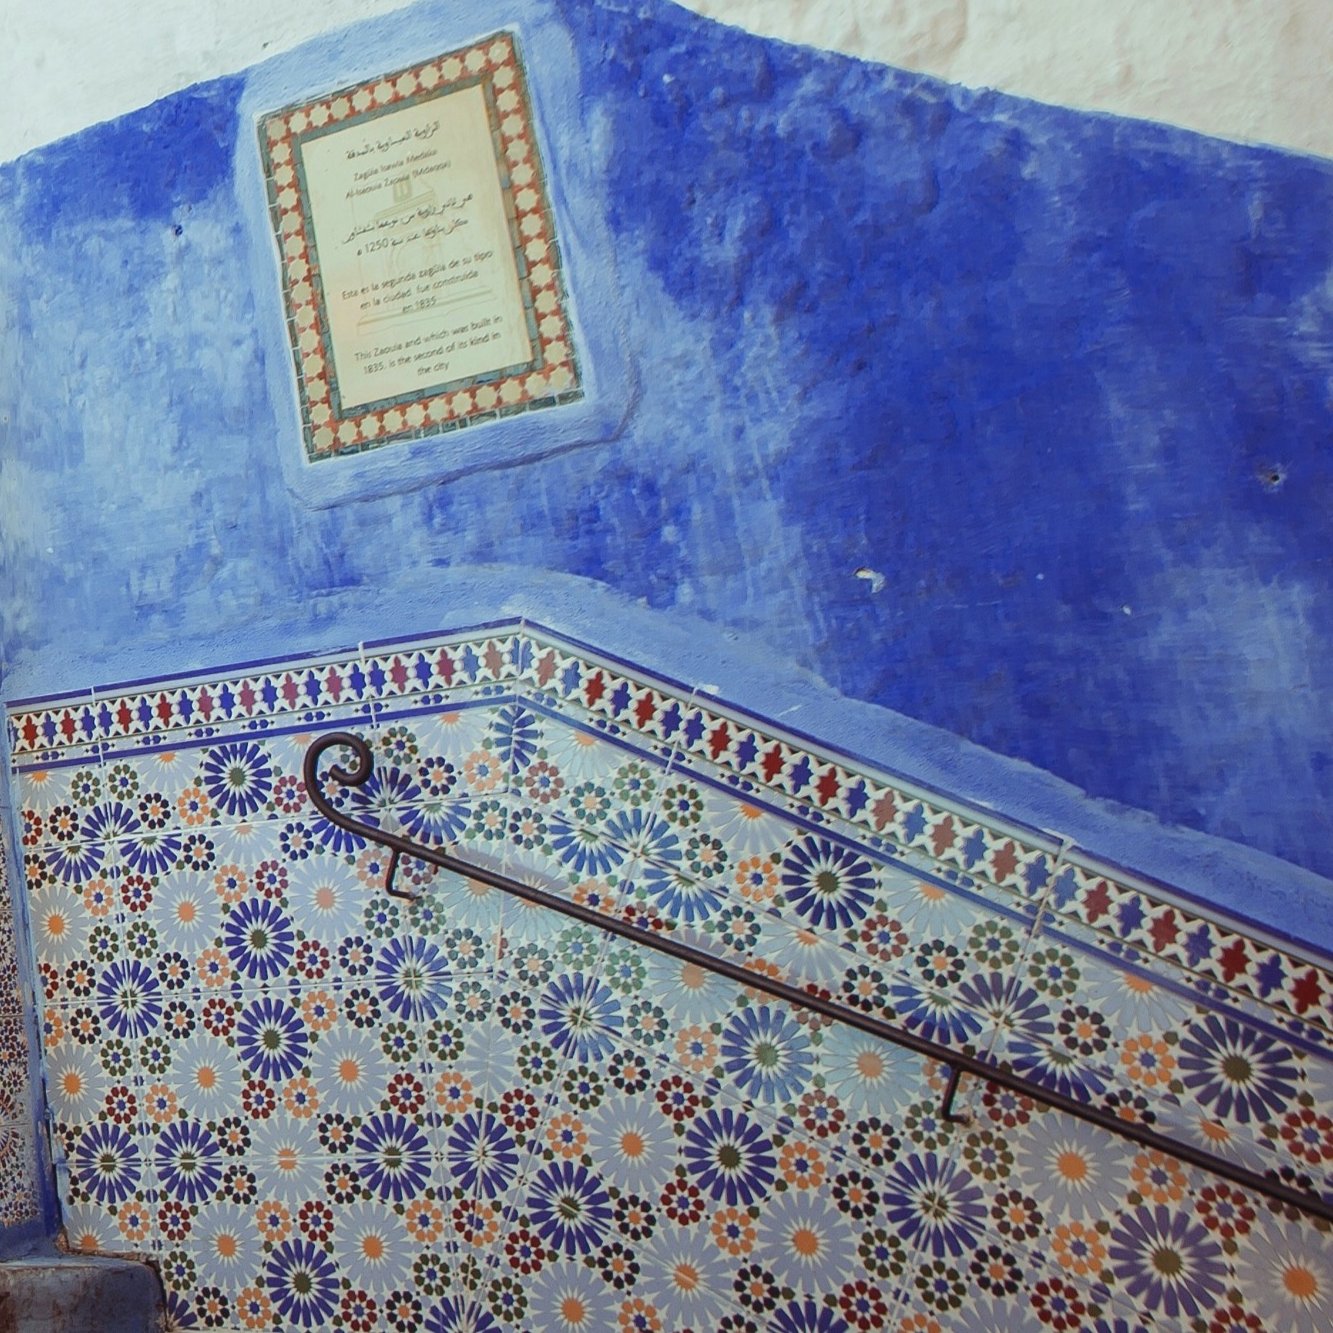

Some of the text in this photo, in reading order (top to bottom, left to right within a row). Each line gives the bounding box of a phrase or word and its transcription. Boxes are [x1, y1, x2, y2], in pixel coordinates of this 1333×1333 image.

[365, 238, 389, 254] 1250
[342, 290, 359, 301] Esta
[360, 287, 370, 295] es
[371, 283, 380, 292] la
[381, 273, 417, 289] segunda
[448, 260, 460, 270] de
[462, 258, 473, 266] su
[474, 251, 494, 262] tipo
[360, 302, 372, 311] en
[373, 298, 381, 307] la
[383, 289, 412, 304] ciudad
[417, 285, 431, 294] fue
[402, 296, 437, 315] en 1835
[354, 316, 504, 362] This Zaouia and which was built in
[397, 356, 412, 366] the
[414, 346, 444, 362] second
[445, 342, 456, 354] of
[458, 341, 469, 350] its
[470, 334, 490, 346] kind
[492, 332, 502, 341] in
[417, 362, 450, 376] the city
